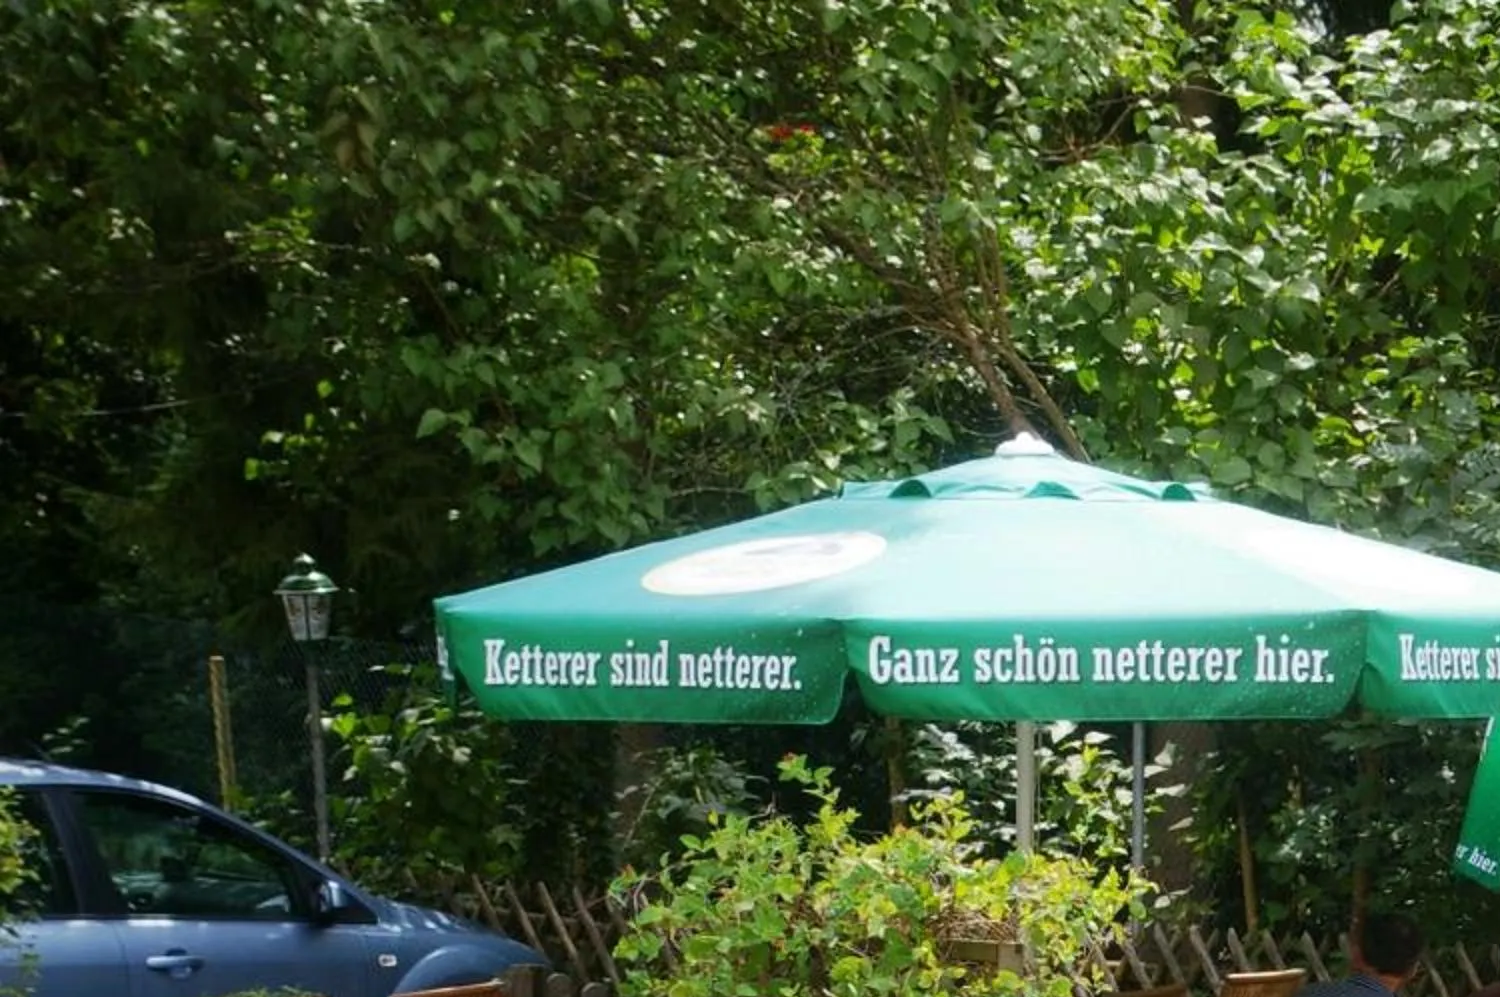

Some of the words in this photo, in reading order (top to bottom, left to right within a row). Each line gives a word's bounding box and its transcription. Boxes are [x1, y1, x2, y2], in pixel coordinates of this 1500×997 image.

[484, 638, 601, 686] Ketterer
[609, 638, 670, 687] sind
[678, 646, 802, 691] netterer.
[868, 634, 960, 684] Ganz
[973, 633, 1080, 683] schön
[1091, 638, 1244, 682] netterer
[1254, 633, 1335, 683] hier.
[1399, 632, 1480, 681] Ketterer
